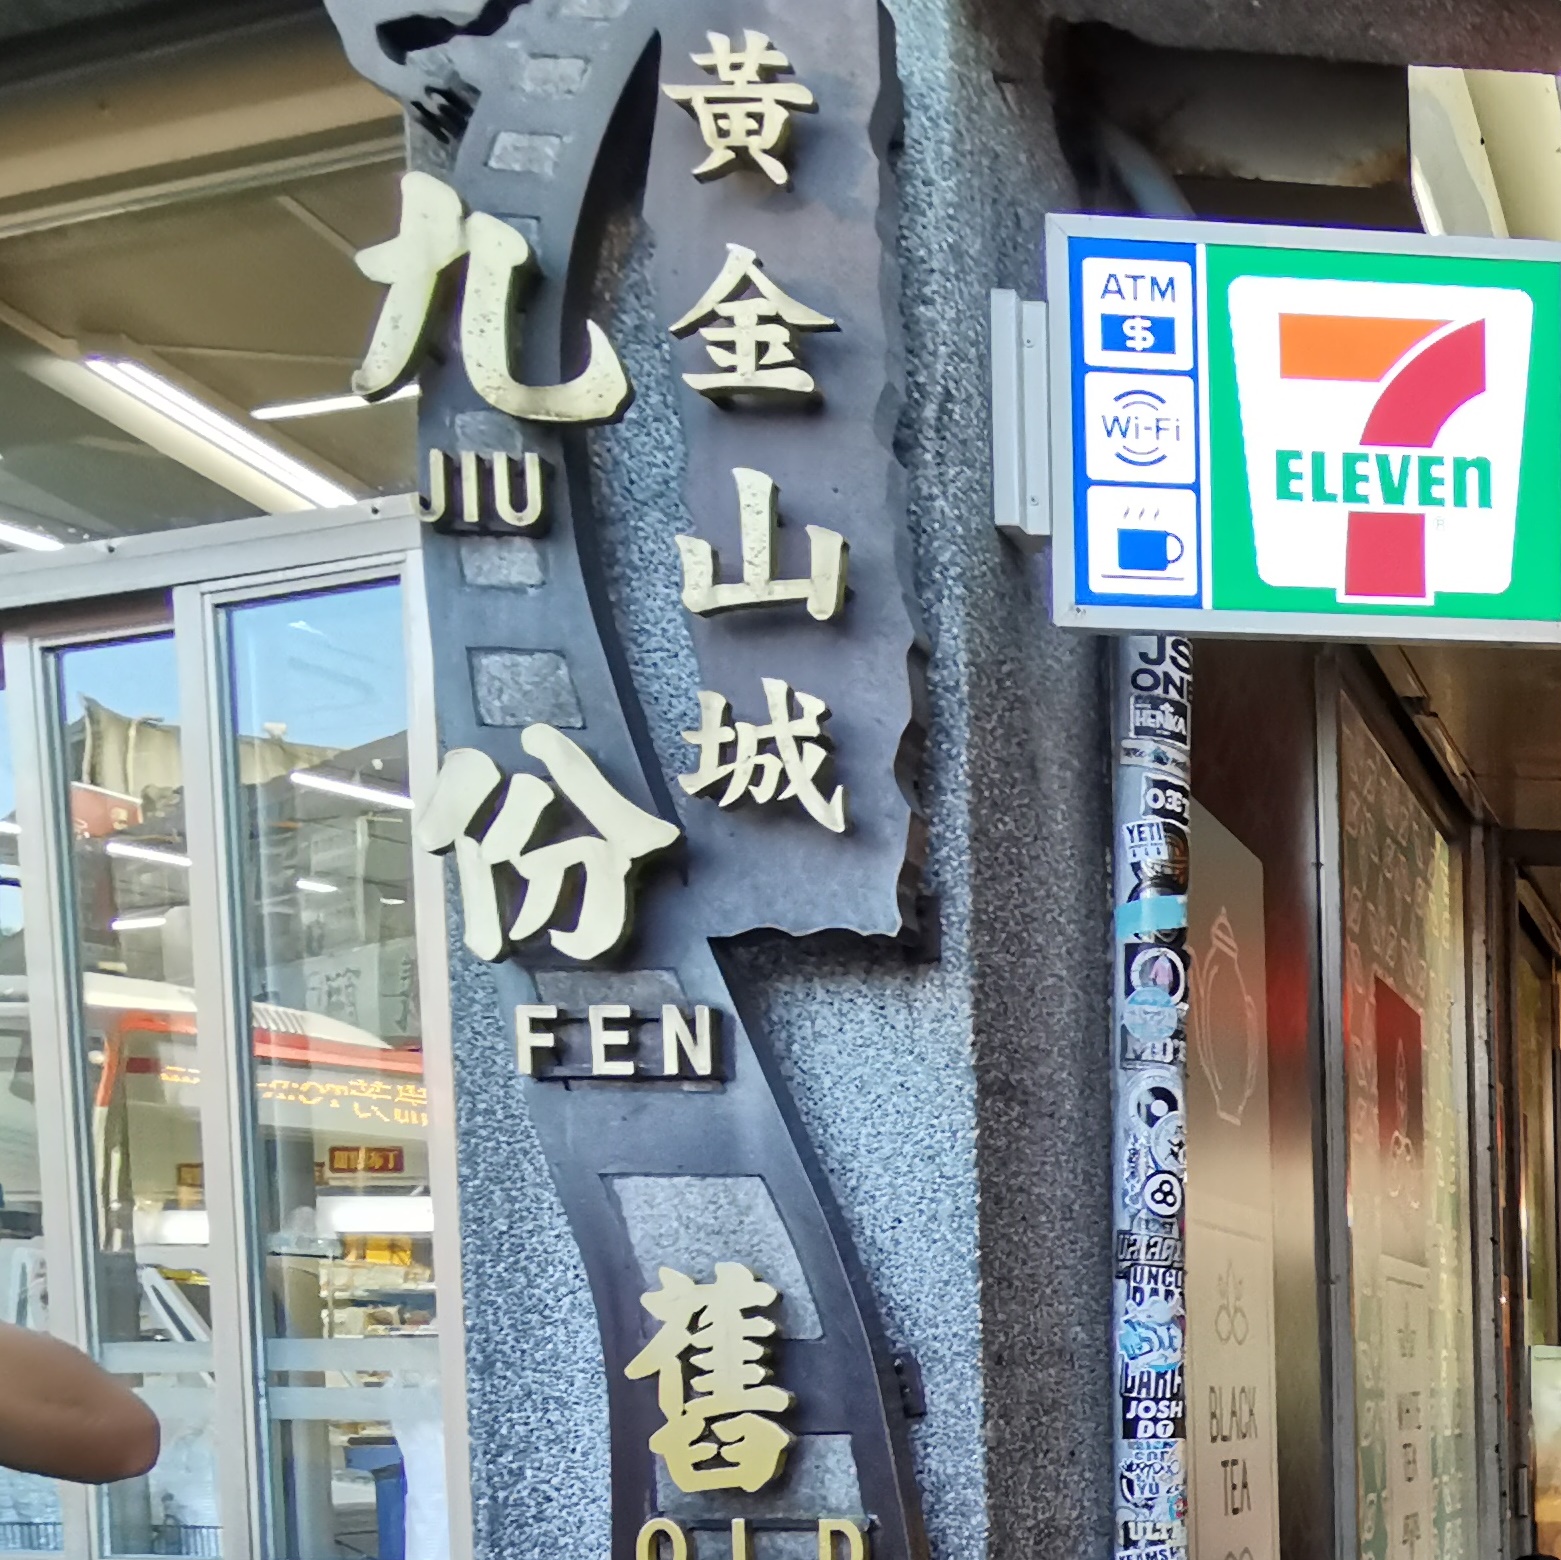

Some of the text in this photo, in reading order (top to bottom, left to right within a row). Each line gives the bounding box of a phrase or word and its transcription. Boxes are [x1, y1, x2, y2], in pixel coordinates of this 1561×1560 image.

[1100, 272, 1176, 303] ATM
[661, 29, 849, 834] 黃金山城
[1101, 414, 1181, 442] Wi-Fi
[418, 447, 545, 526] JIU
[515, 1002, 713, 1077] FEN
[1126, 1400, 1184, 1420] JOSH
[1208, 1385, 1258, 1443] BLACK
[1219, 1458, 1252, 1517] TEA
